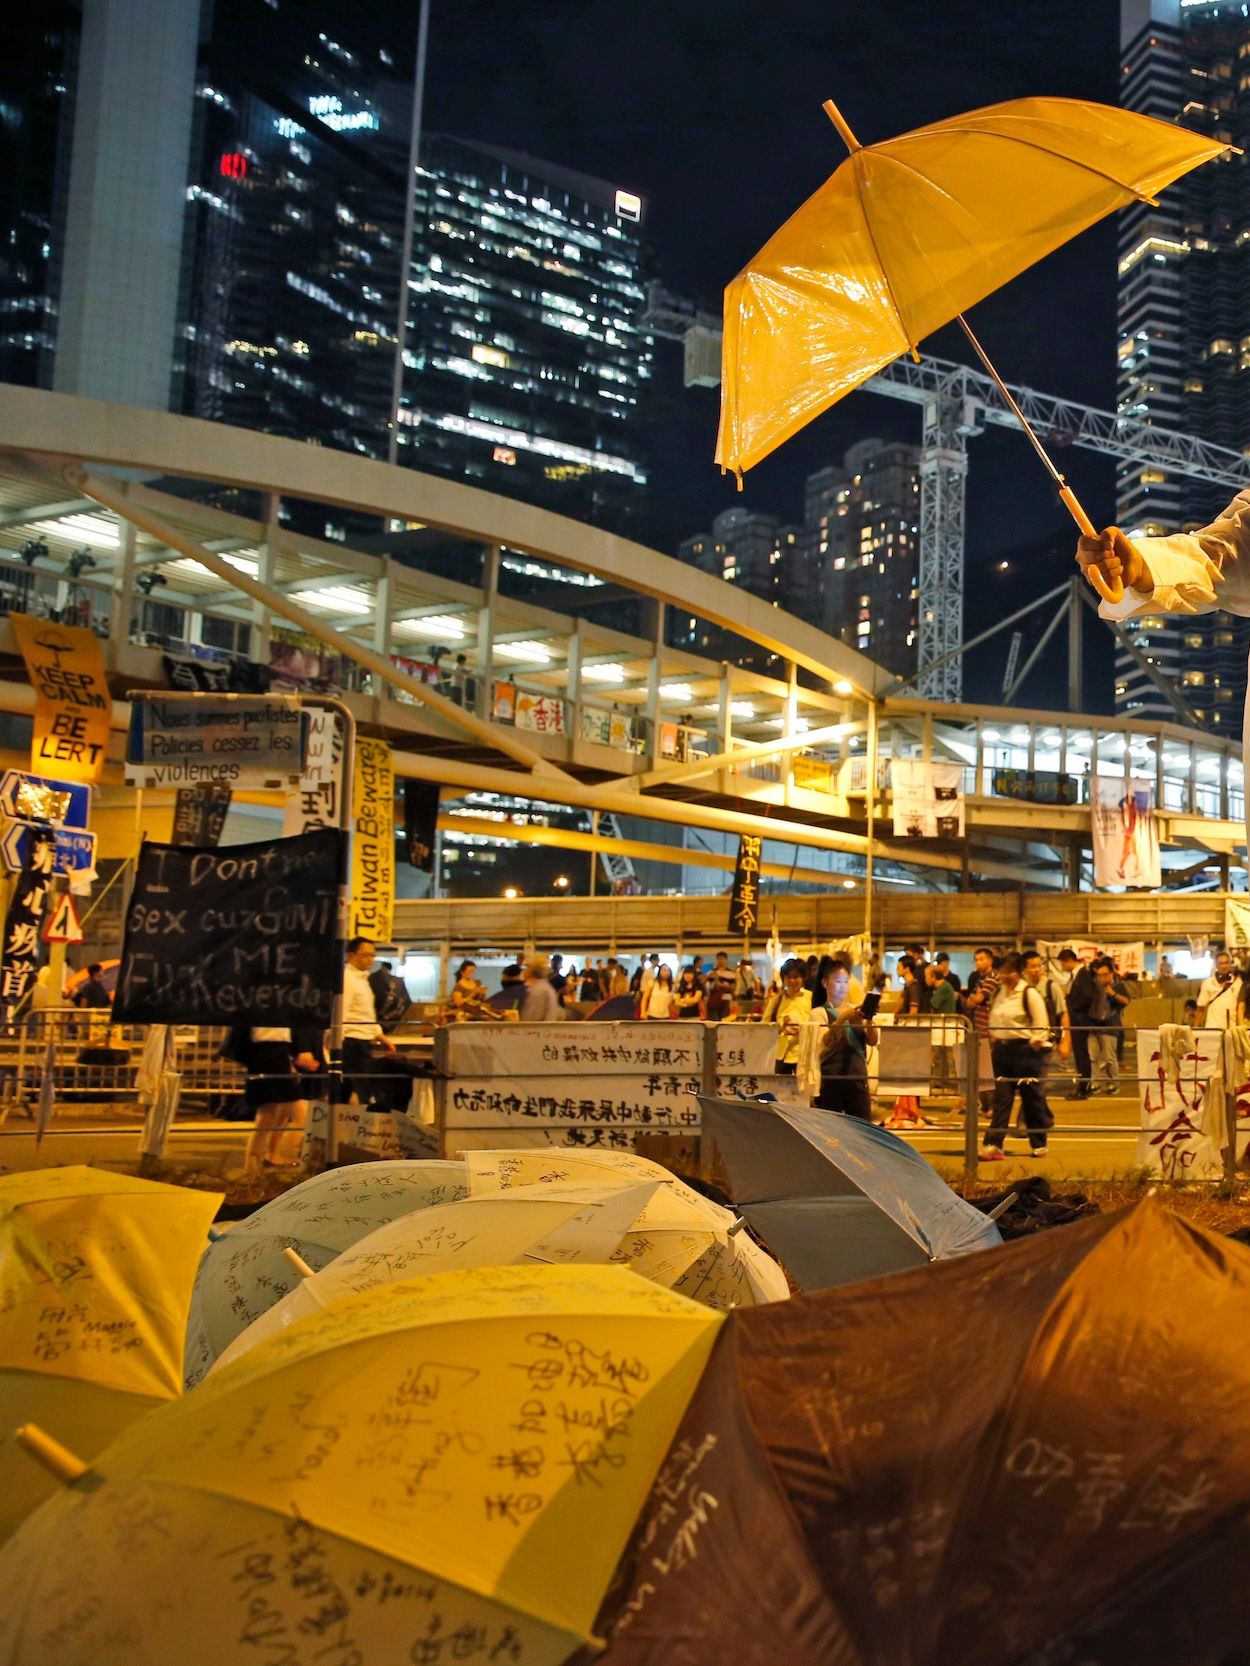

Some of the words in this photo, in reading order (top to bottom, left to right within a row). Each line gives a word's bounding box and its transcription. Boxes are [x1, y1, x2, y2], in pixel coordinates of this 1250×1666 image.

[33, 664, 95, 690] KEEP
[40, 684, 106, 709] CALM
[52, 714, 88, 739] BE
[267, 730, 292, 750] les
[153, 758, 240, 783] violences
[146, 849, 178, 893] I
[354, 844, 379, 937] Taiwan
[232, 942, 300, 975] ME
